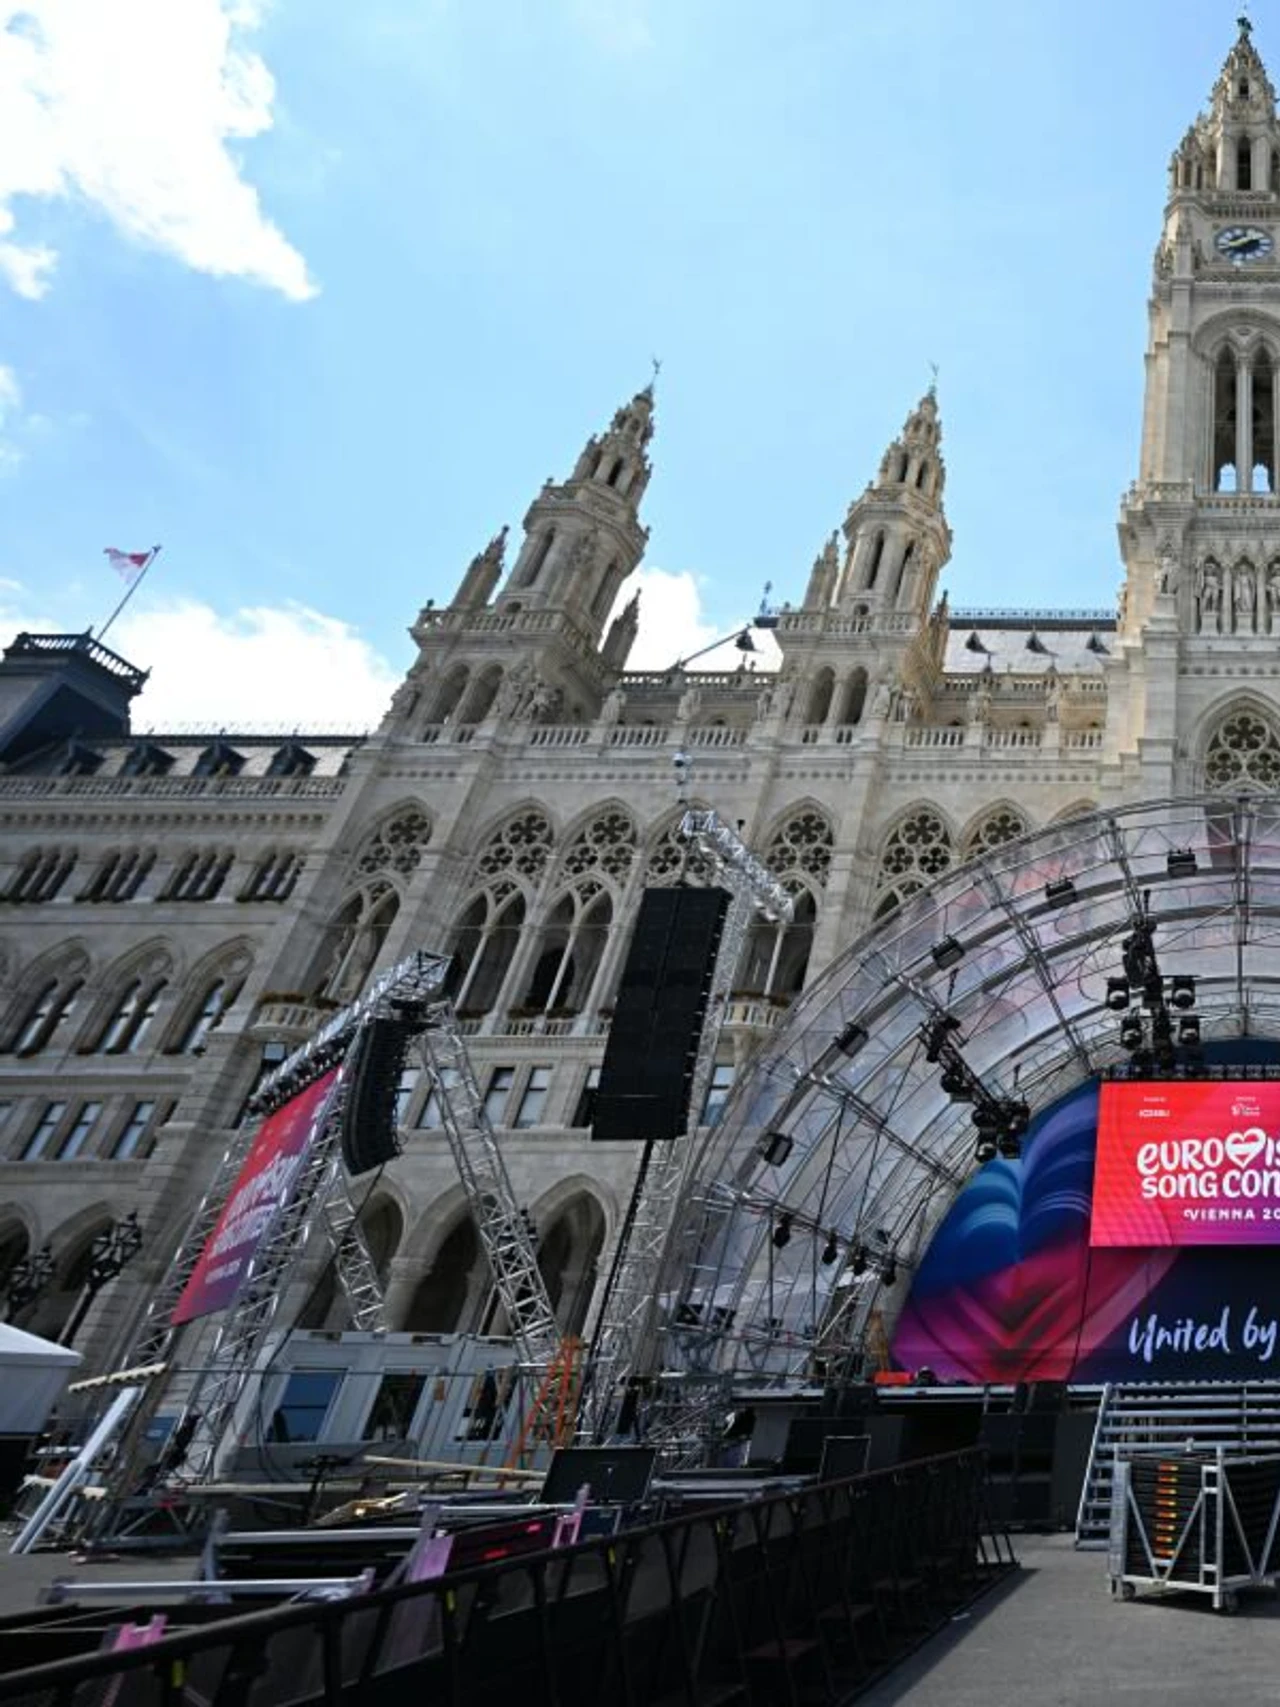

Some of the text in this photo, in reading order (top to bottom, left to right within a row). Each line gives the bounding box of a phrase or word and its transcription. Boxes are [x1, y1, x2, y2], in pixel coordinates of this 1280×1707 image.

[1141, 1171, 1218, 1199] SONG
[1183, 1208, 1255, 1220] VIENNA
[1128, 1306, 1230, 1363] United
[1243, 1306, 1277, 1362] by
